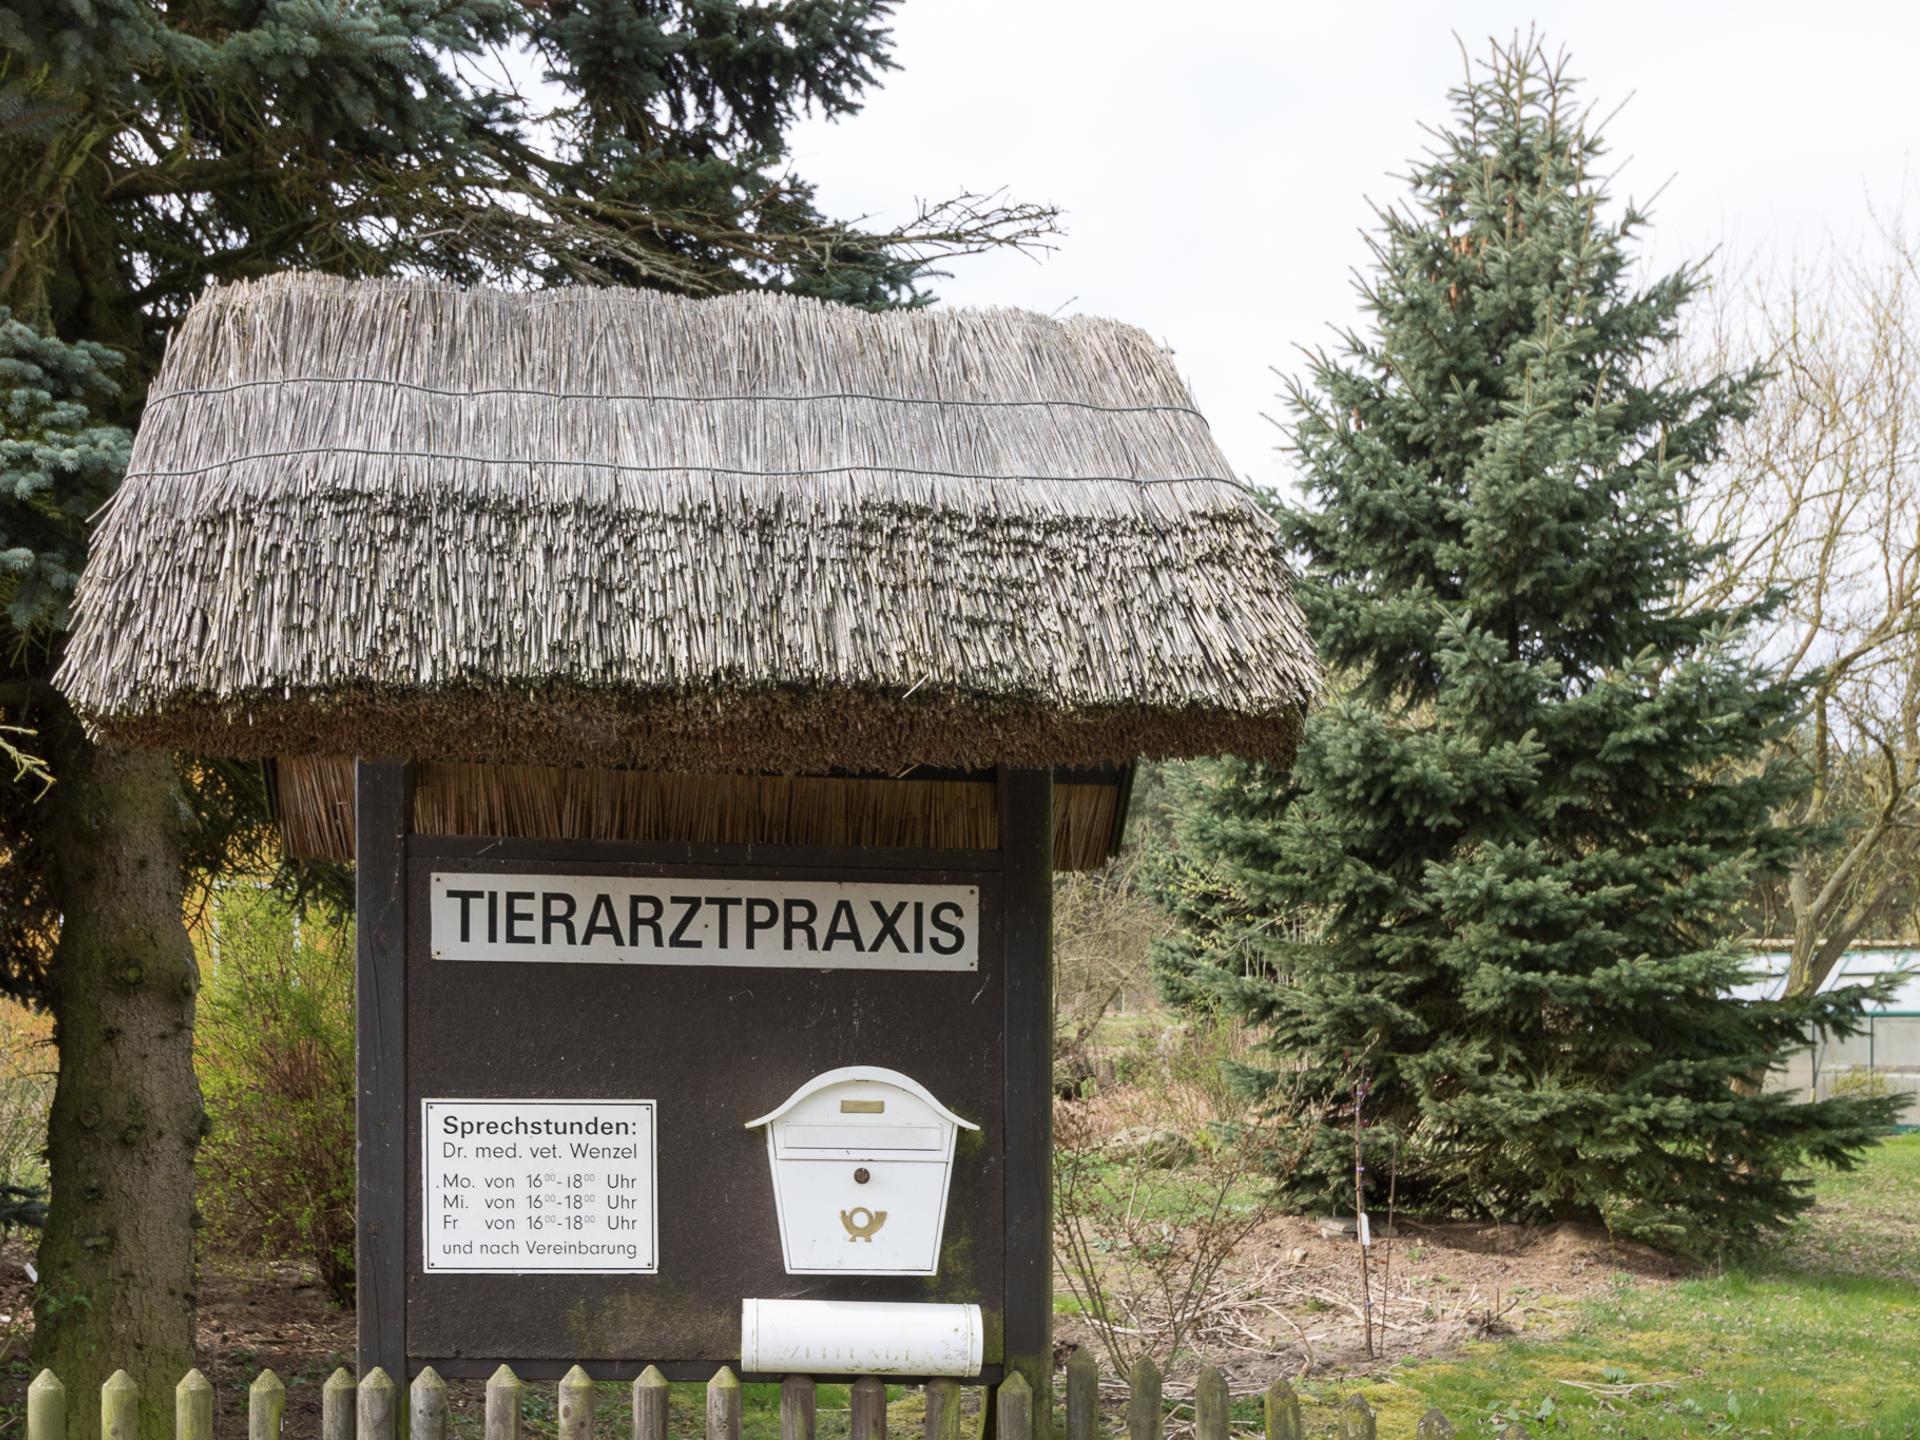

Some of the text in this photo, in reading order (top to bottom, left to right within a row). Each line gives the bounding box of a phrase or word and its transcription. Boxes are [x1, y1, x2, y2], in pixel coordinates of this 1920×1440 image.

[447, 890, 965, 956] TIERARZTPRAXIS
[443, 1116, 637, 1139] Sprechstunden:
[443, 1142, 638, 1160] Dr. med. vet. Wenzel
[443, 1173, 476, 1189] Mo.
[484, 1177, 516, 1189] von
[607, 1173, 638, 1189] Uhr
[443, 1194, 469, 1210] Mi.
[484, 1198, 516, 1210] von
[607, 1194, 638, 1210] Uhr
[484, 1219, 516, 1231] von
[607, 1215, 638, 1231] Uhr
[442, 1240, 638, 1260] und nach Vereinbarung
